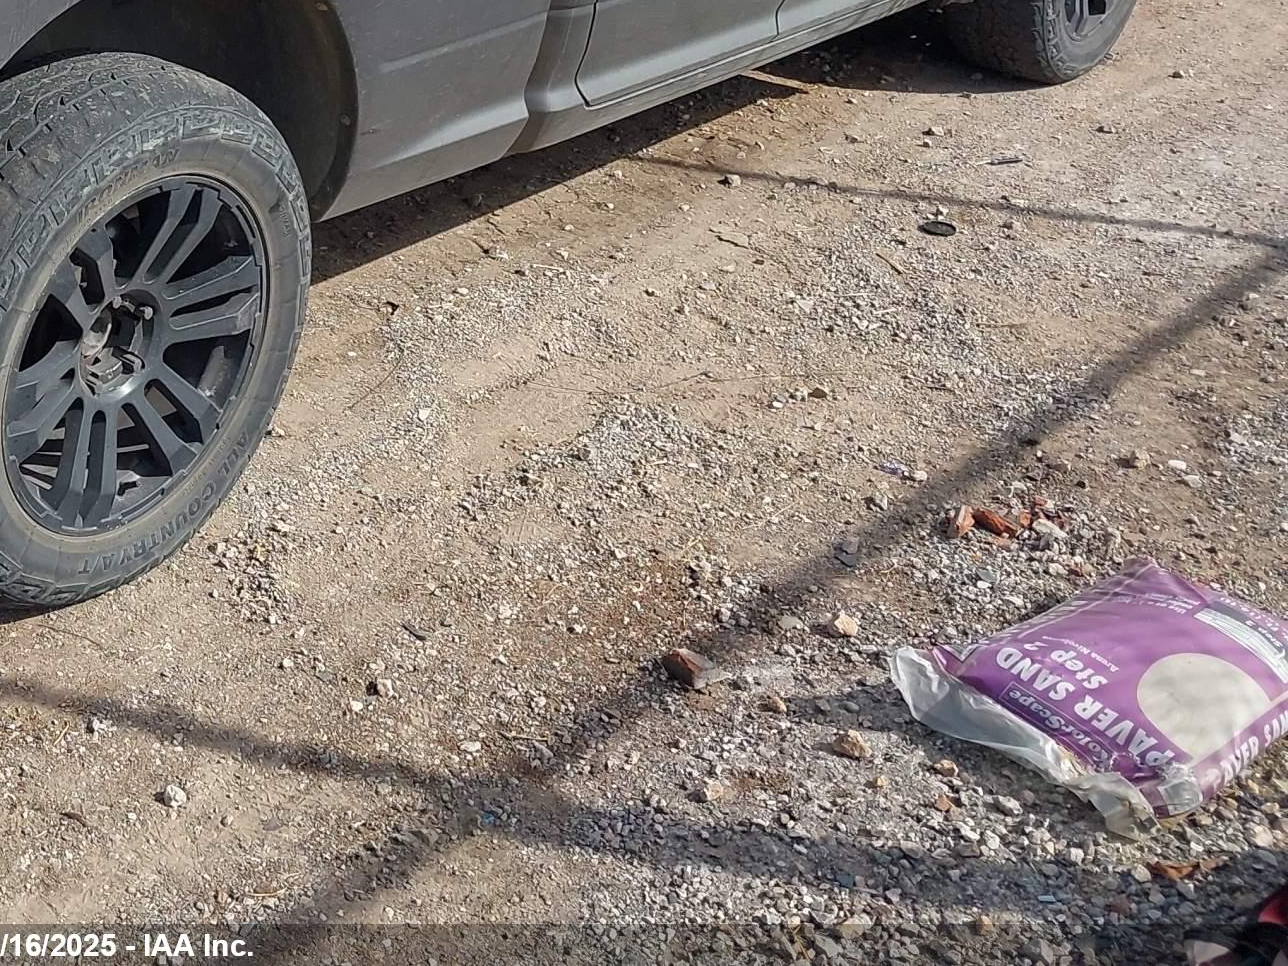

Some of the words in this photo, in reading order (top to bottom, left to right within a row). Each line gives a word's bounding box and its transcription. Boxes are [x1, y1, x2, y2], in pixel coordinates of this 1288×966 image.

[217, 432, 250, 476] ALL
[119, 481, 217, 566] COUNTRY
[78, 553, 115, 575] A/T
[996, 647, 1076, 701] SAND
[1050, 649, 1109, 690] Step
[1009, 689, 1111, 771] KolorScape
[1074, 694, 1175, 766] PAVER
